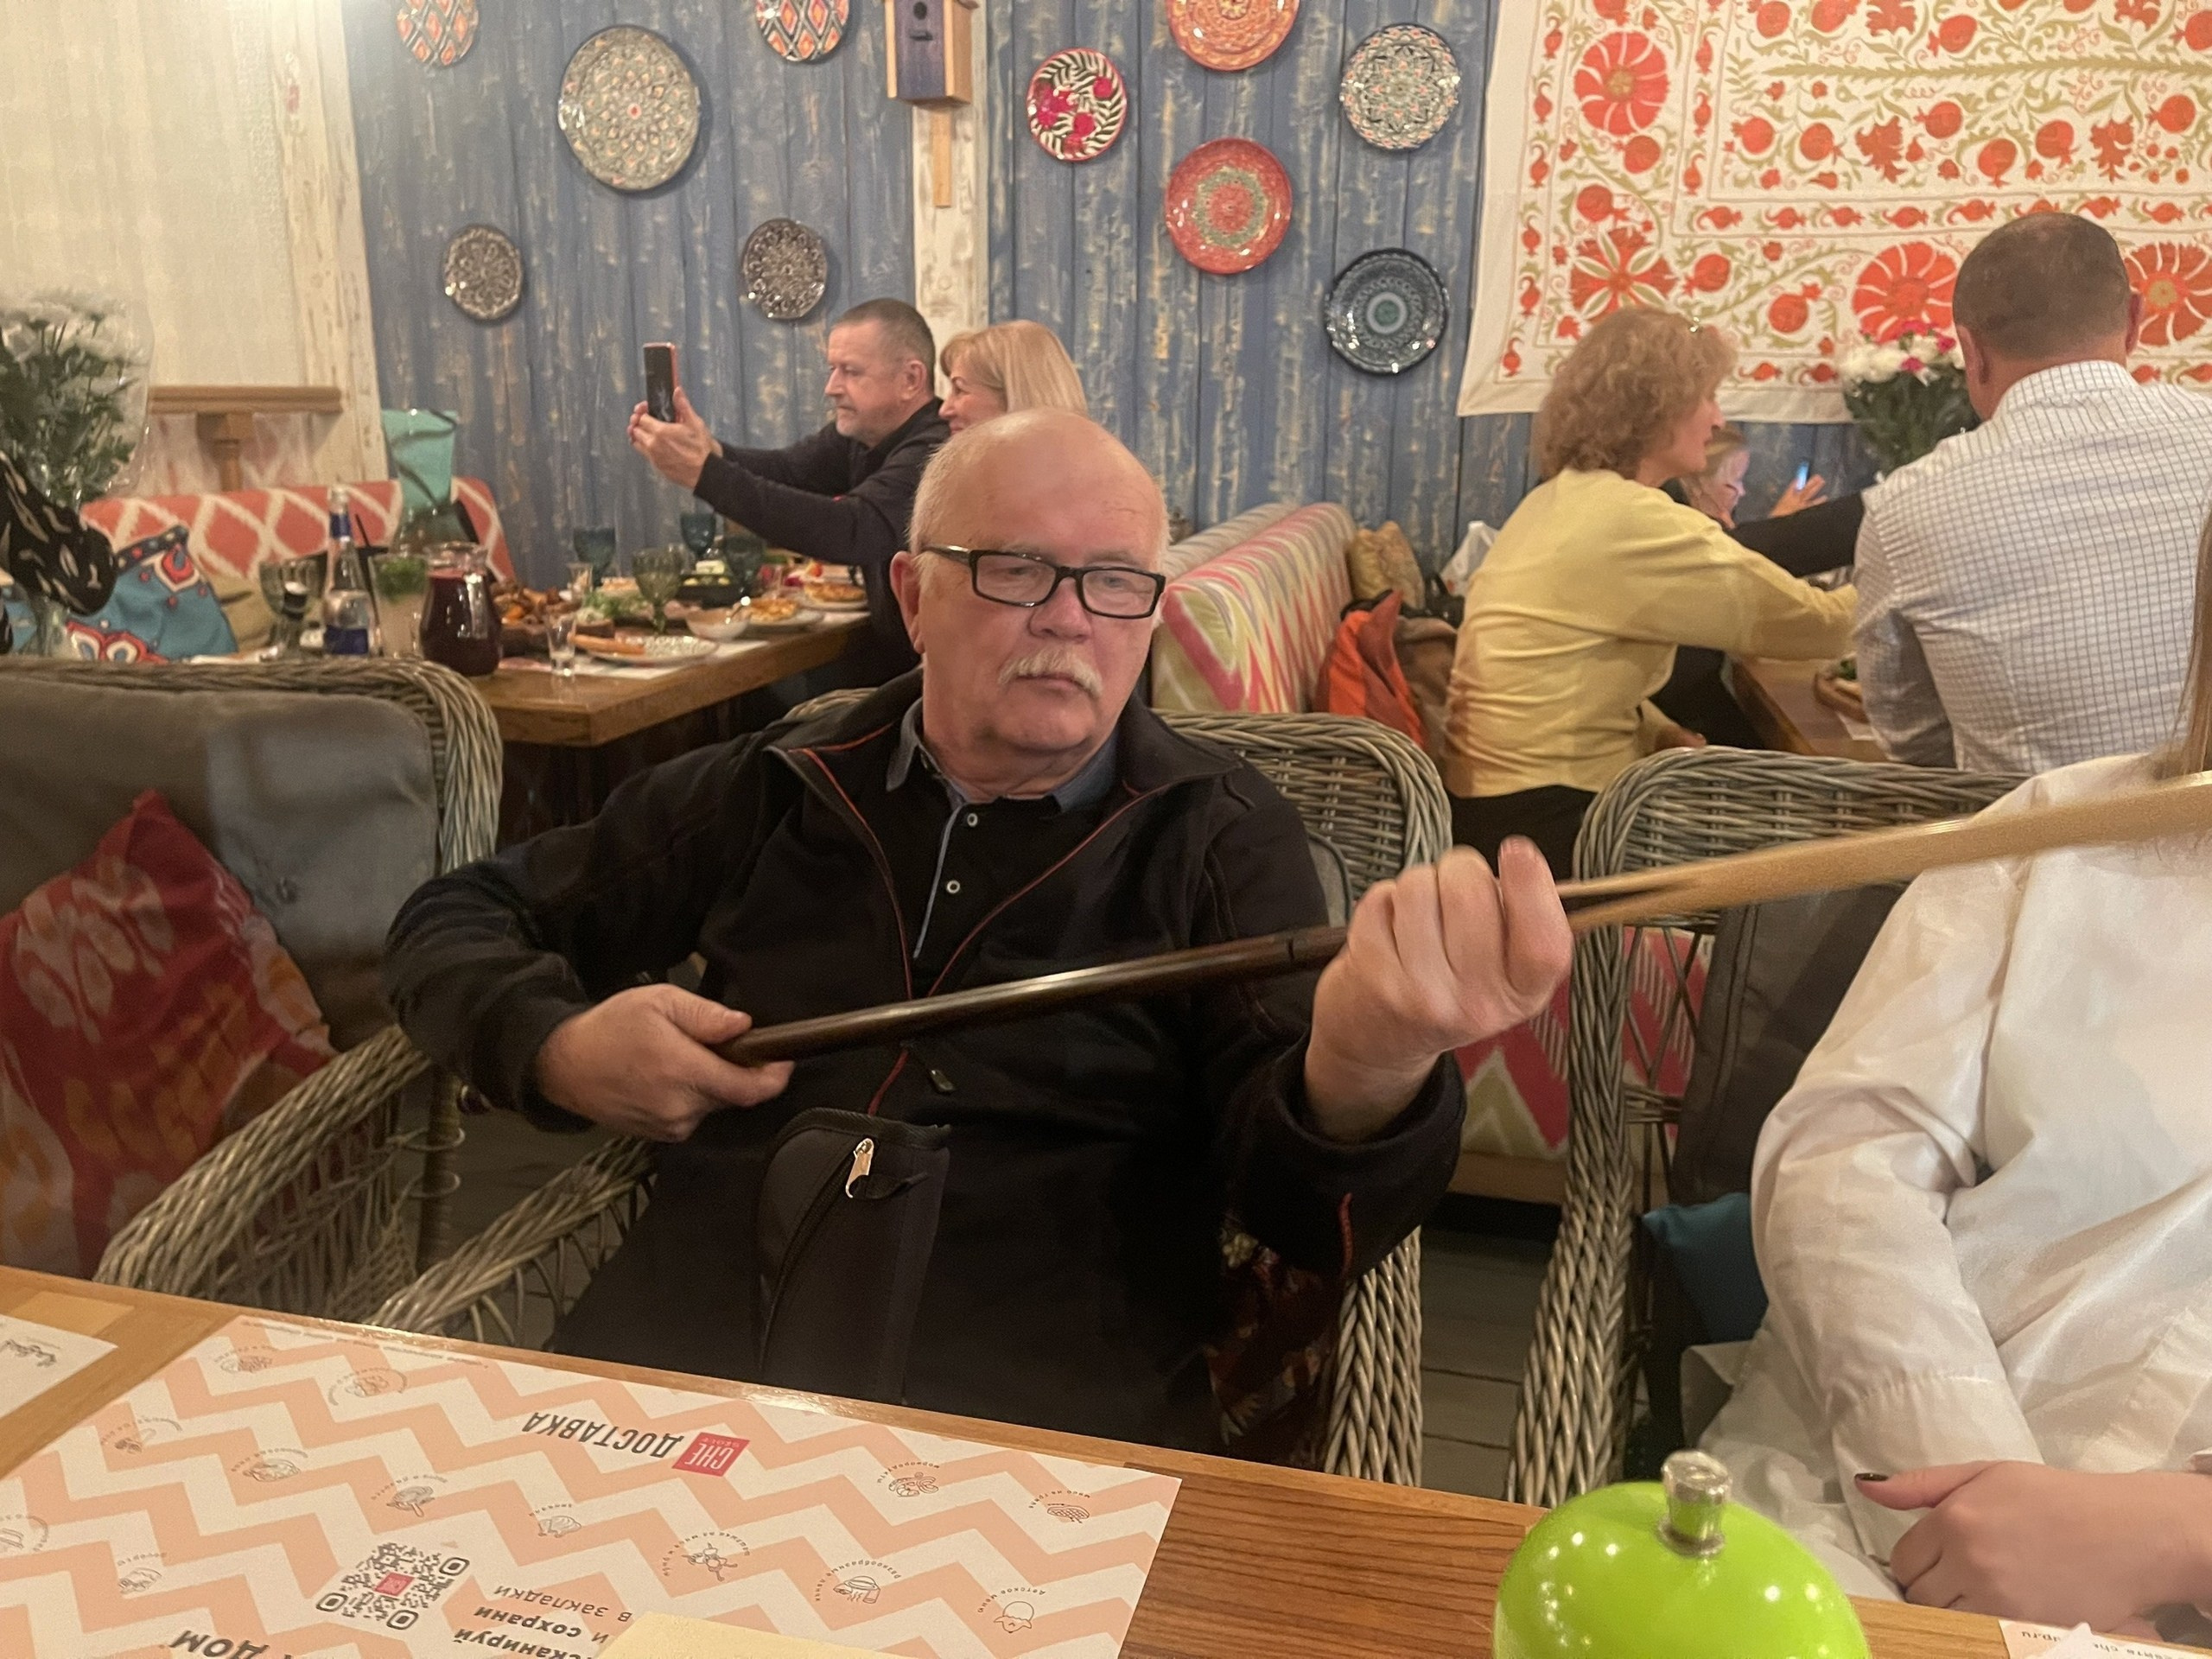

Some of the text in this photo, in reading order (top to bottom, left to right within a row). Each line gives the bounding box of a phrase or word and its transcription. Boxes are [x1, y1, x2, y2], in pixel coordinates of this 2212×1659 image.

[521, 1412, 684, 1459] ДОСТАВКА
[876, 1461, 940, 1483] морепродукты
[825, 1559, 901, 1580] разнообразные
[493, 1585, 632, 1623] в закладки
[977, 1587, 1046, 1613] детское меню
[473, 1605, 610, 1644] и сохрани
